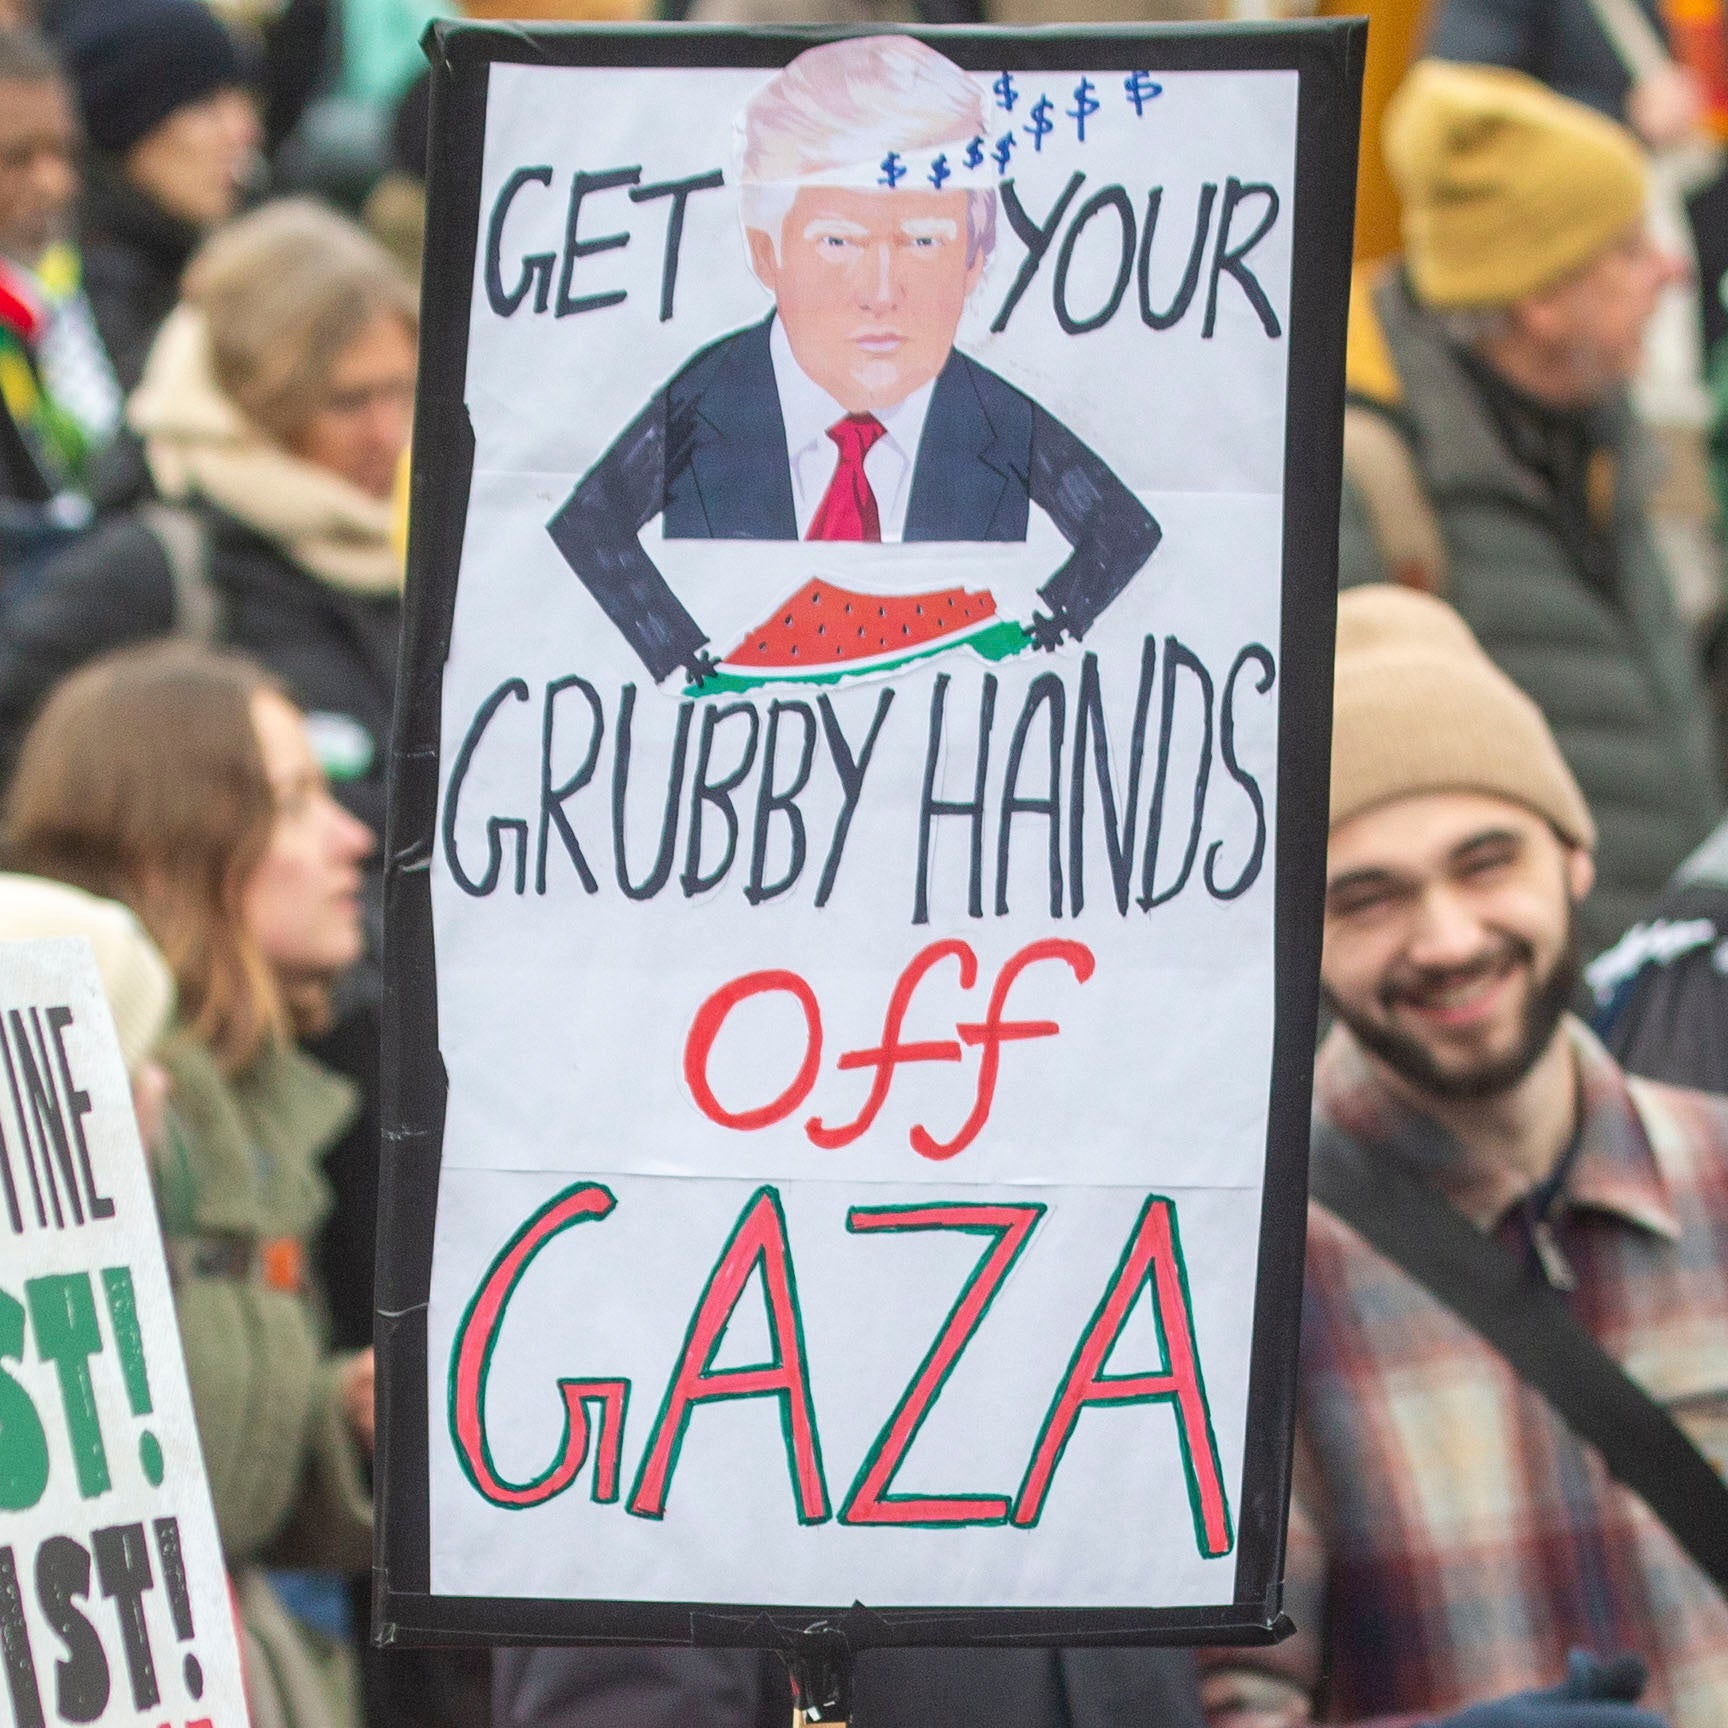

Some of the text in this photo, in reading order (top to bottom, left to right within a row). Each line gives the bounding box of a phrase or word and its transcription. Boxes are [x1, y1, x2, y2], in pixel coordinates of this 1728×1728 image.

[485, 164, 1282, 339] GET YOUR
[442, 634, 1276, 924] GRUBBY HANDS
[447, 1182, 1236, 1559] GAZA
